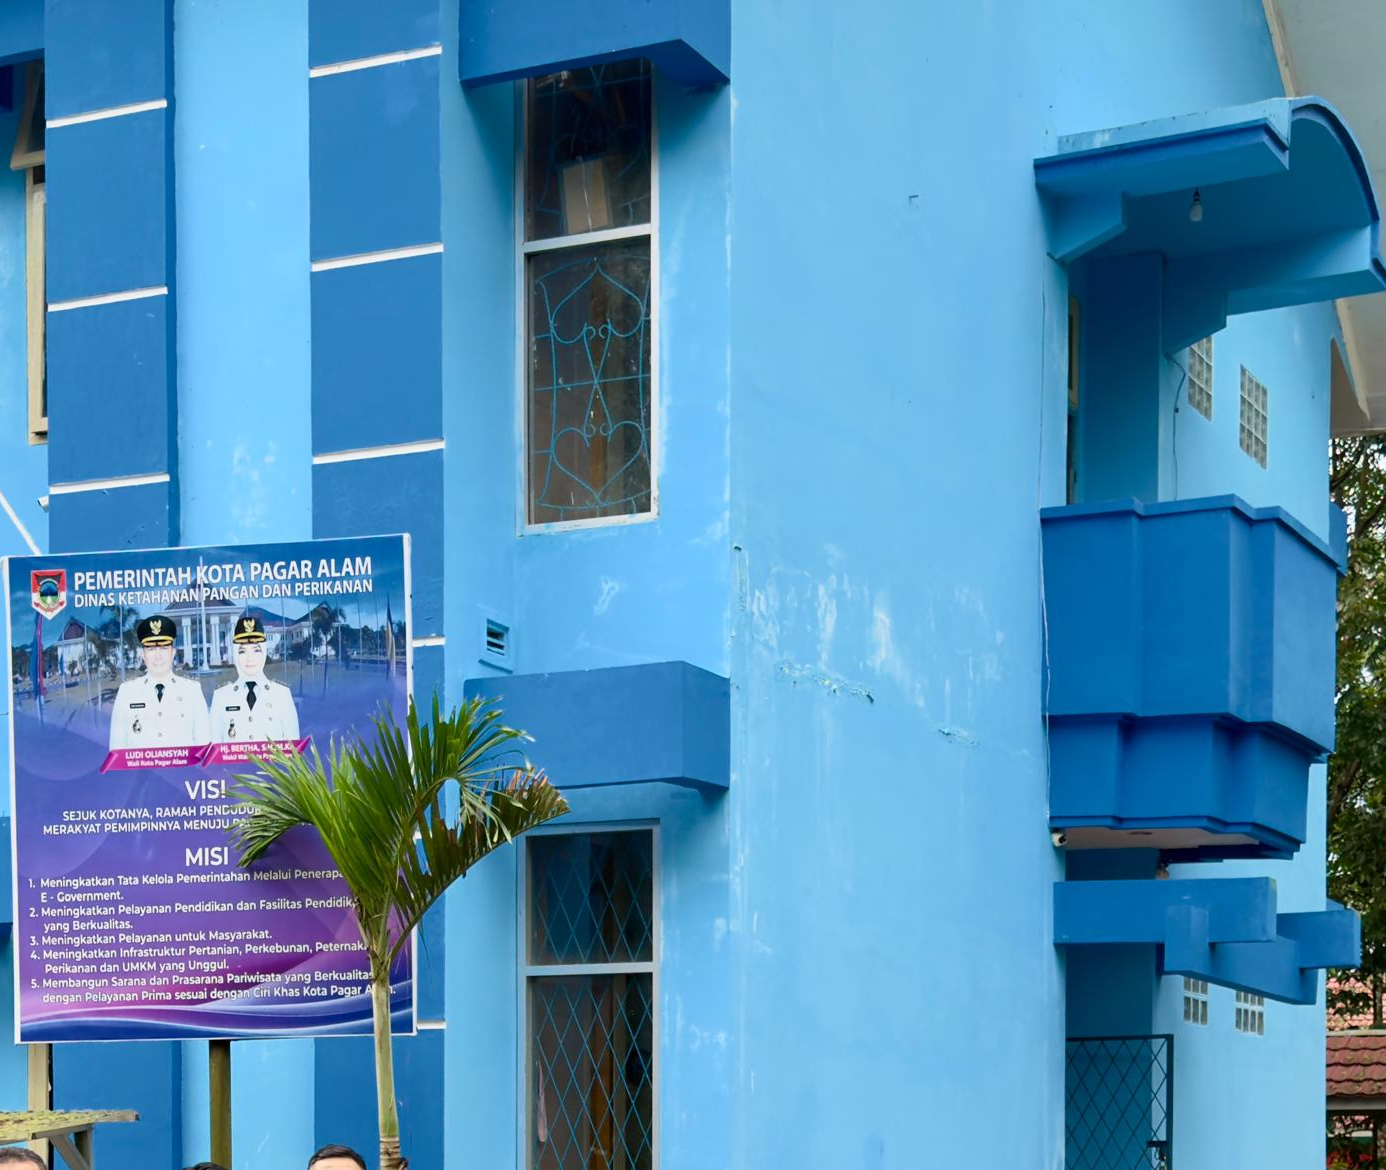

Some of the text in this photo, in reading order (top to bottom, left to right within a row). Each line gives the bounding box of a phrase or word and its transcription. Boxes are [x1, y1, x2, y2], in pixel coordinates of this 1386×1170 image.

[74, 556, 372, 591] PEMERINTAH KOTA PAGAR ALAM
[74, 579, 373, 608] DINAS KETAHANAN PANGAN DAN PERIKANAN
[125, 749, 189, 760] LUDI OLIANSYAH
[62, 809, 97, 822] SEJUK
[100, 807, 153, 820] KOTANYA,
[156, 805, 196, 818] RAMAH
[43, 823, 102, 836] MERAKYAT
[104, 821, 181, 834] PEMIMPINNYA
[184, 818, 229, 831] MENUJU
[185, 847, 229, 867] MISI
[28, 878, 36, 889] 1.
[40, 876, 114, 890] Meningkatkan
[117, 875, 139, 886] Tata
[142, 874, 174, 885] Kelola
[176, 871, 250, 885] Pemerintahan
[253, 869, 292, 881] Melalui
[40, 891, 48, 902] E
[57, 890, 124, 902] Government.
[29, 907, 39, 918] 2.
[41, 905, 114, 919] Meningkatkan
[118, 903, 171, 917] Pelayanan
[174, 900, 233, 914] Pendidikan
[236, 900, 257, 912] dan
[259, 898, 302, 910] Fasilitas
[44, 919, 133, 933] yang Berkualitas.
[29, 929, 273, 947] 3. Meningkatkan Pelayanan untuk Masyarakat.
[29, 950, 40, 960] 4.
[43, 948, 116, 962] Meningkatkan
[120, 946, 186, 958] Infrastruktur
[189, 943, 242, 957] Pertanian,
[245, 942, 313, 955] Perkebunan,
[45, 958, 229, 974] Perikanan dan UMKM yang Unggul.
[30, 979, 39, 989] 5.
[43, 976, 109, 990] Membangun
[111, 975, 146, 987] Sarana
[149, 974, 169, 985] dan
[172, 973, 224, 985] Prasarana
[226, 971, 282, 983] Pariwisata
[285, 972, 311, 984] yang
[43, 993, 83, 1005] dengan
[85, 991, 139, 1004] Pelayanan
[141, 990, 172, 1001] Prima
[174, 988, 207, 1000] sesuai
[210, 988, 250, 1001] dengan
[253, 986, 271, 998] Ciri
[273, 986, 301, 997] Khas
[303, 985, 328, 996] Kota
[330, 984, 363, 998] Pagar
